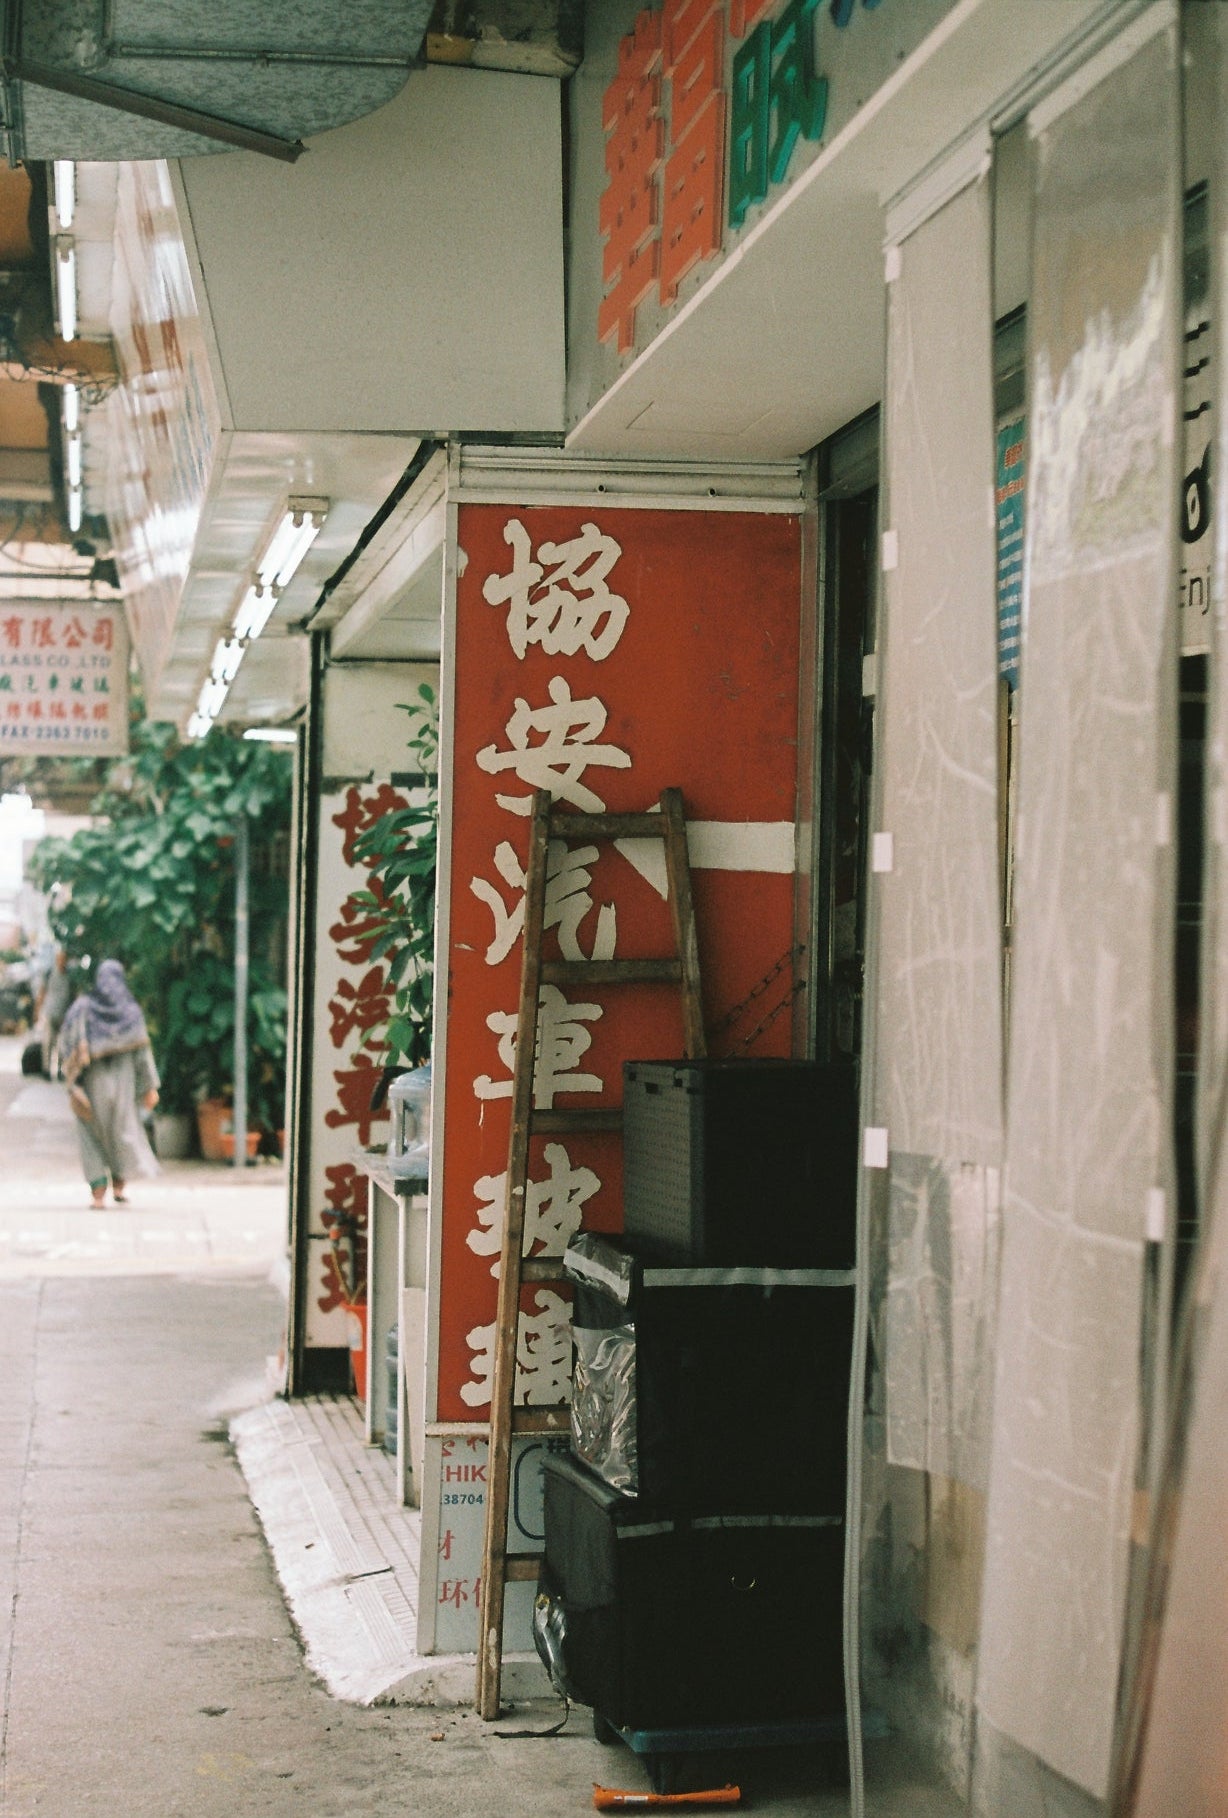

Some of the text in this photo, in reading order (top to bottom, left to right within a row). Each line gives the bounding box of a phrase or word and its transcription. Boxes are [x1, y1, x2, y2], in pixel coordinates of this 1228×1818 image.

[2, 616, 114, 651] 有限公司
[441, 1464, 488, 1483] HIK
[440, 1493, 484, 1506] 38704
